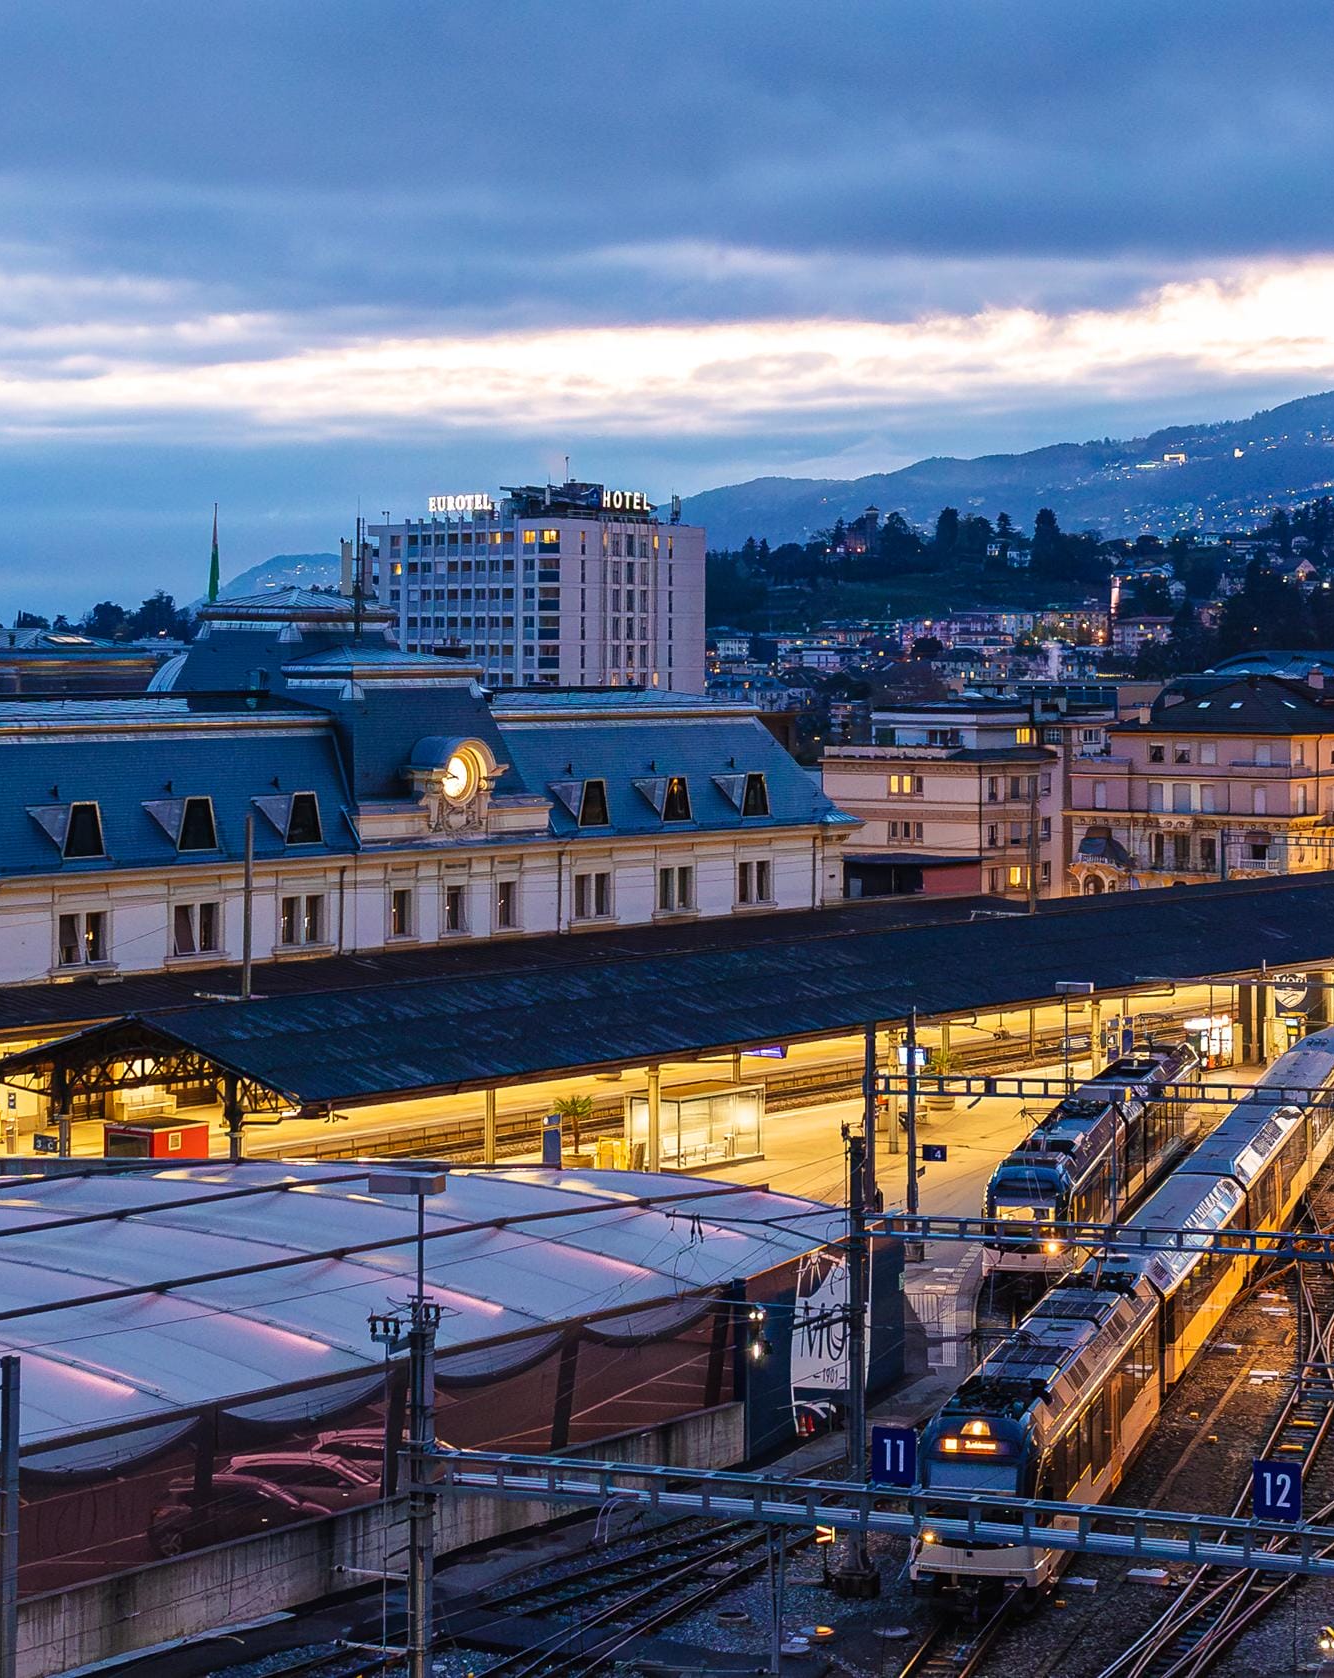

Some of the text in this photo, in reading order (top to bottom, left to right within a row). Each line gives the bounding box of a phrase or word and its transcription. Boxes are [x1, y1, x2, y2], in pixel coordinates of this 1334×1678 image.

[428, 493, 492, 512] EUROTEL
[602, 490, 651, 511] HOTEL
[36, 1139, 42, 1149] 3
[934, 1149, 942, 1159] 4
[800, 1301, 850, 1361] MO
[822, 1368, 839, 1384] 1901
[883, 1438, 905, 1473] 11
[1263, 1472, 1291, 1508] 12
